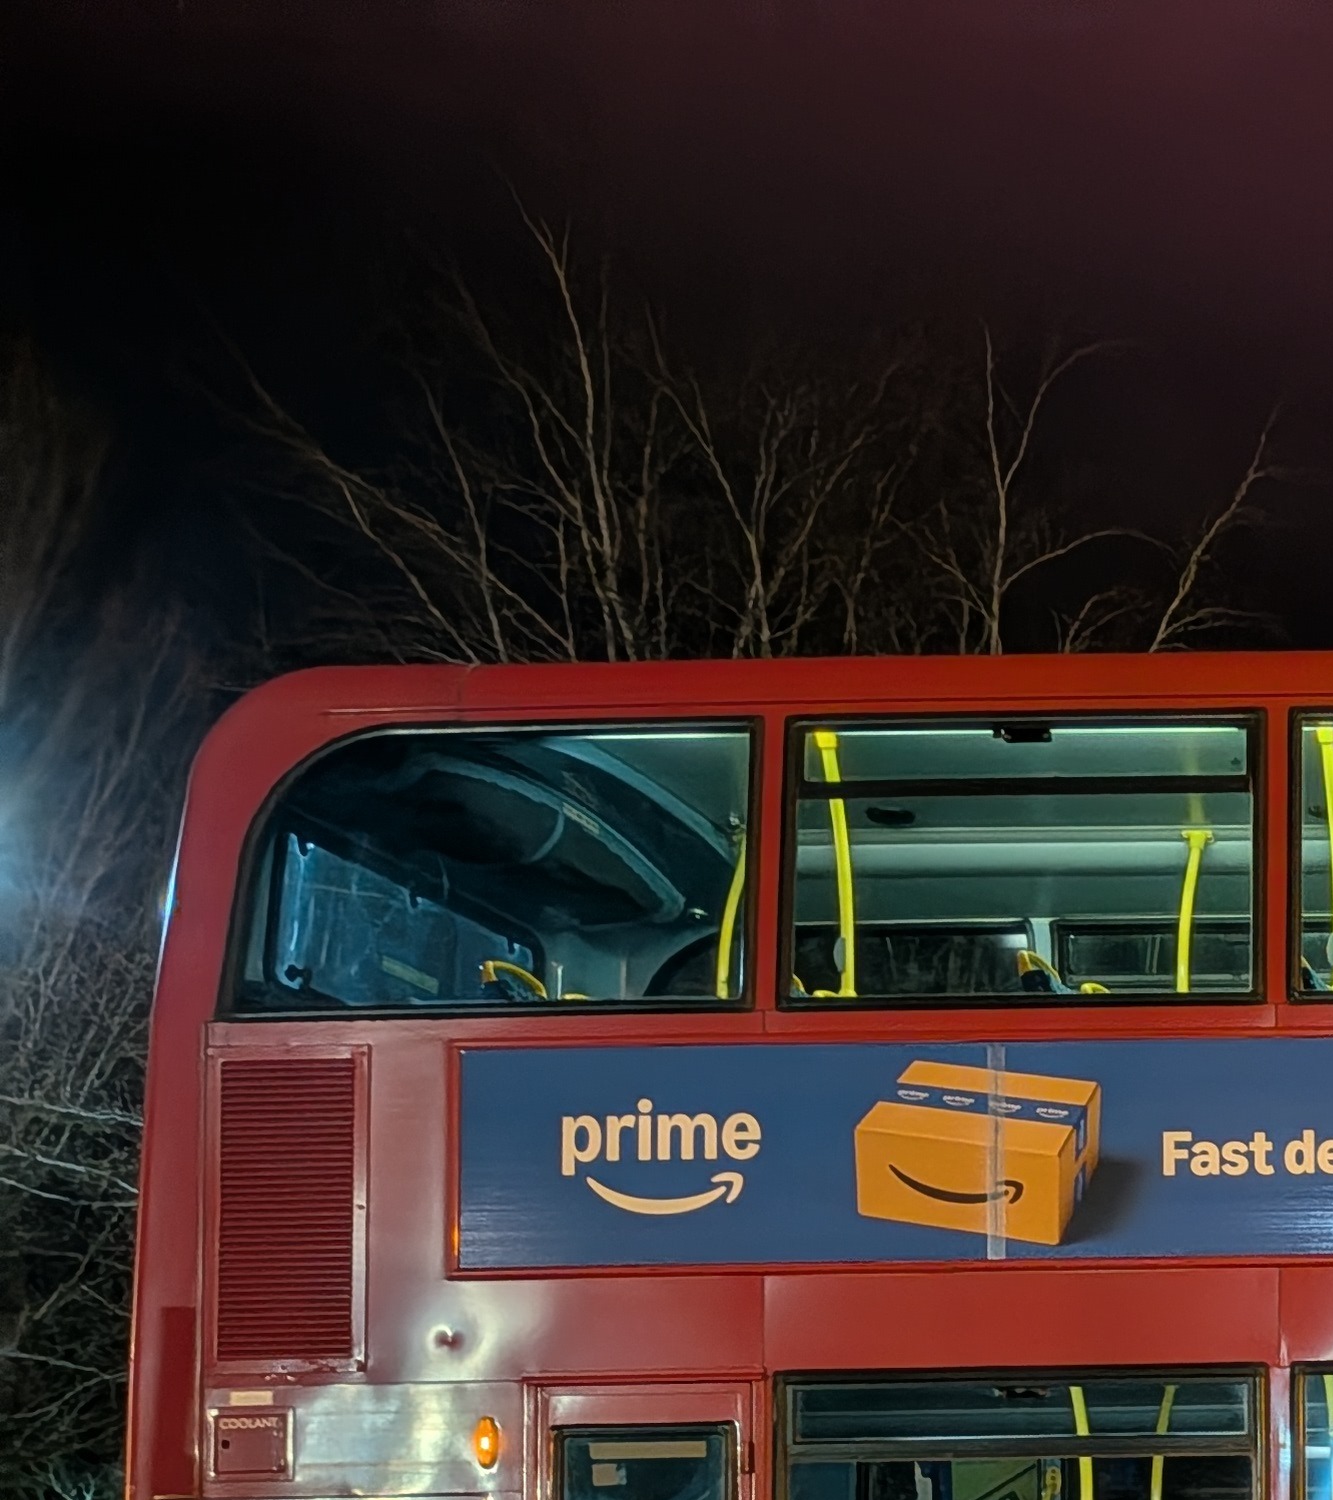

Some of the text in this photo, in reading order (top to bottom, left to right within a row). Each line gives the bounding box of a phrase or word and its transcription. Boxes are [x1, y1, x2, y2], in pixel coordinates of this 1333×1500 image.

[560, 1098, 762, 1177] prime
[1161, 1131, 1275, 1177] Fast
[219, 1416, 279, 1430] COOLANT
